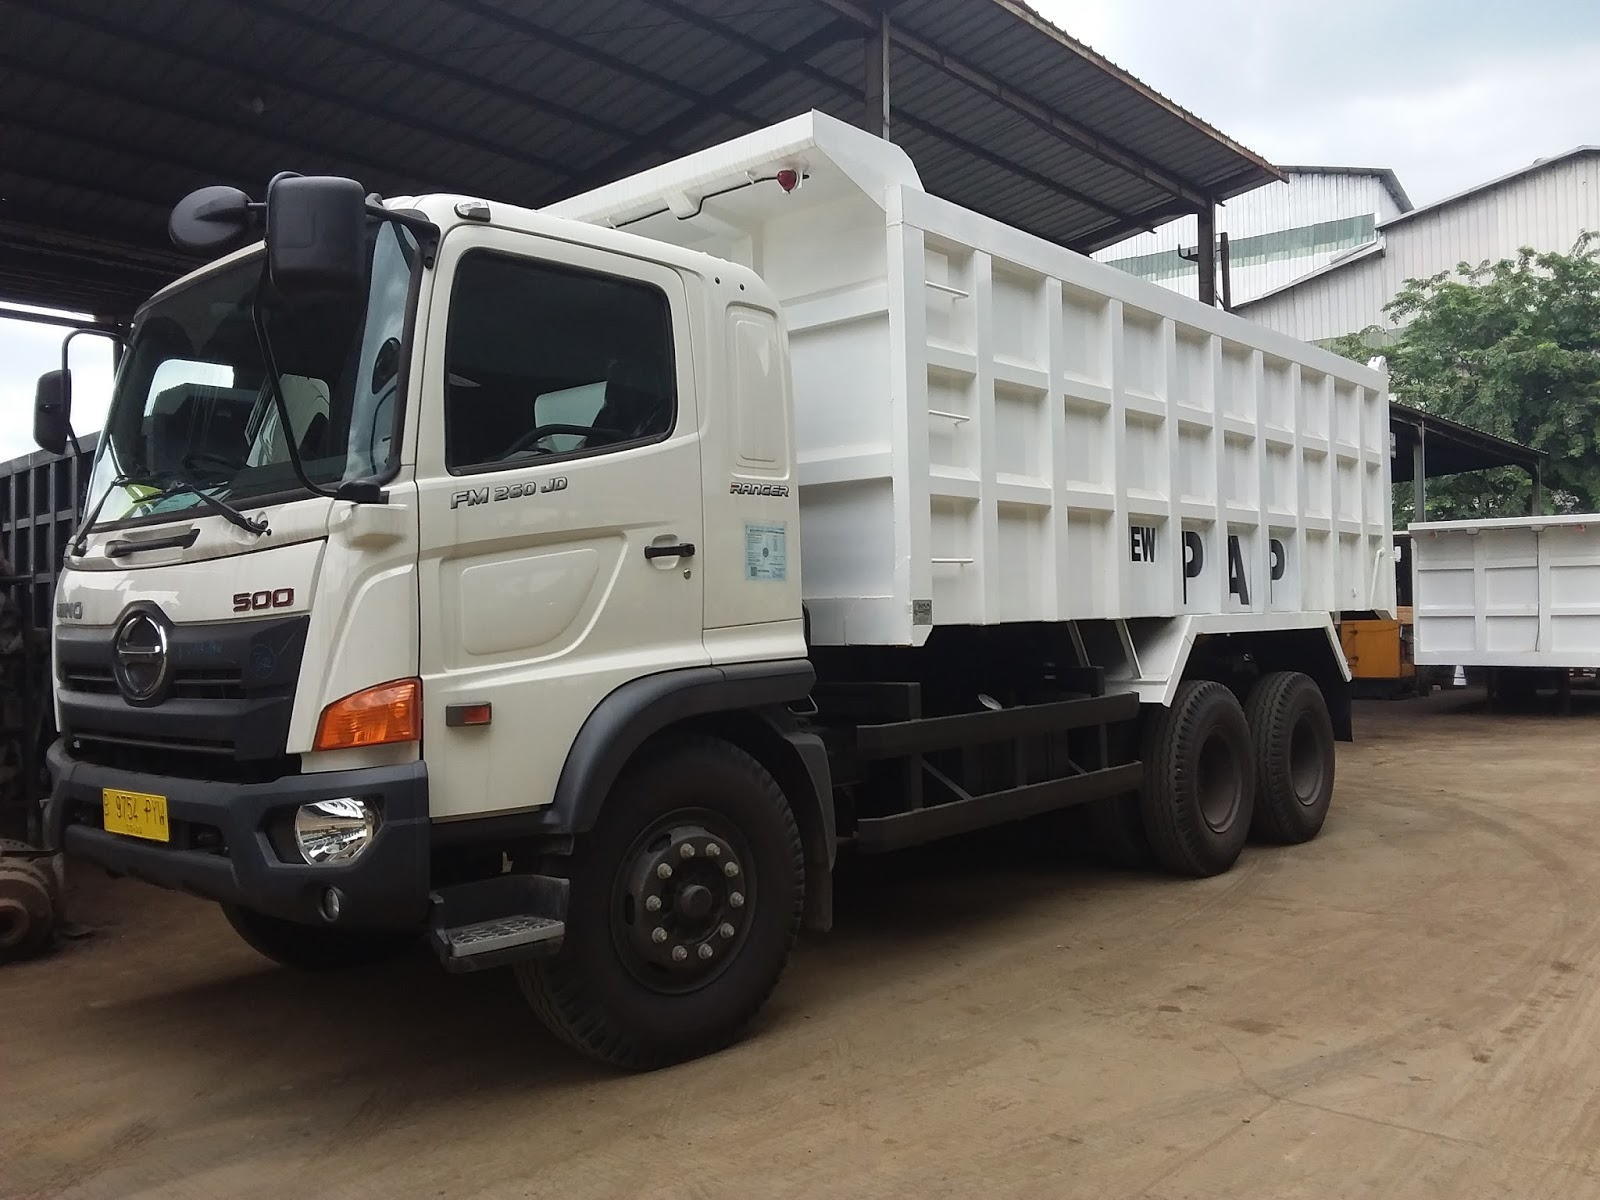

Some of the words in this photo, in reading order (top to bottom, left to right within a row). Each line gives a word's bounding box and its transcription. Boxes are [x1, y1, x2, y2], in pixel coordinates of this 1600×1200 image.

[450, 486, 490, 510] FM
[494, 481, 536, 502] 260
[540, 476, 568, 494] JD
[729, 481, 790, 498] RANGER
[232, 588, 294, 612] 500
[56, 602, 84, 619] NO
